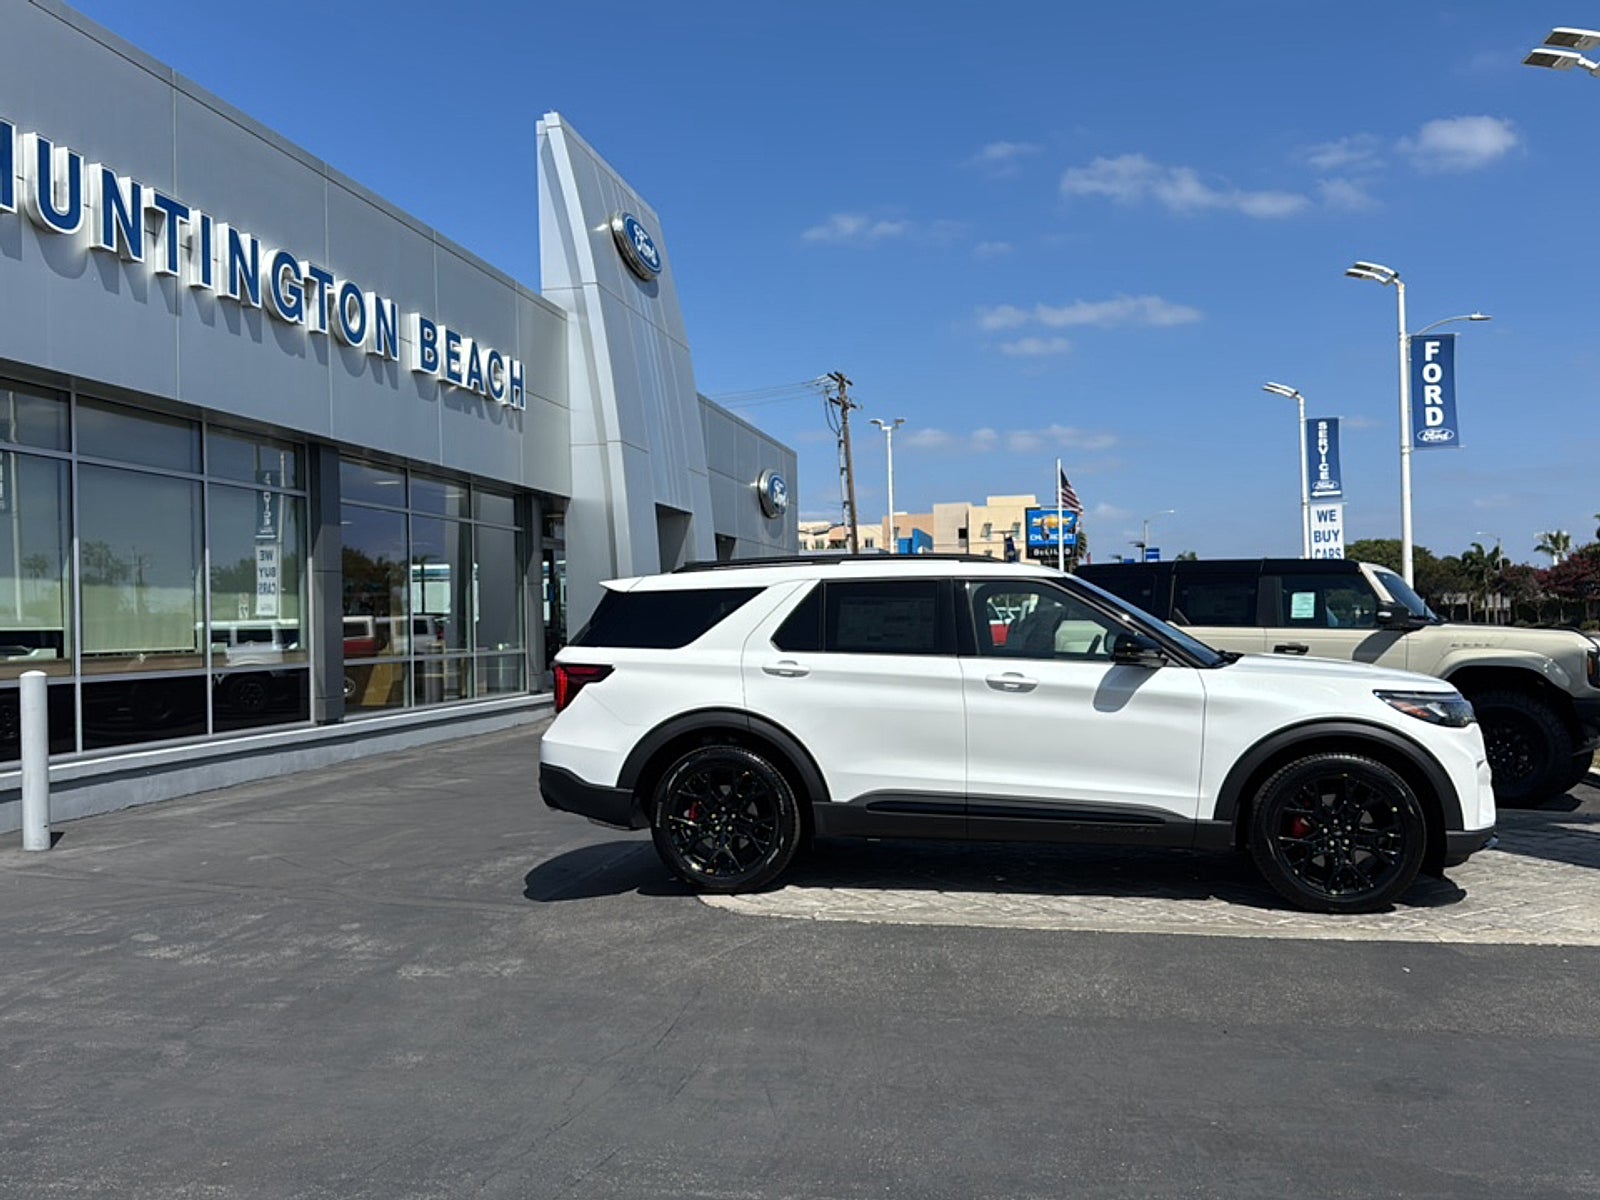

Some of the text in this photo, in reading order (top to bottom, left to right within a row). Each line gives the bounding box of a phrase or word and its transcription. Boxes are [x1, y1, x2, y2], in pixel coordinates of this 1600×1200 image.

[412, 312, 526, 410] BEACH
[1422, 341, 1445, 427] FORD
[1421, 428, 1449, 442] Ford
[1317, 421, 1330, 480] SERVICE
[1316, 509, 1337, 523] WE
[1313, 529, 1340, 543] BUY
[1315, 547, 1341, 560] CARS
